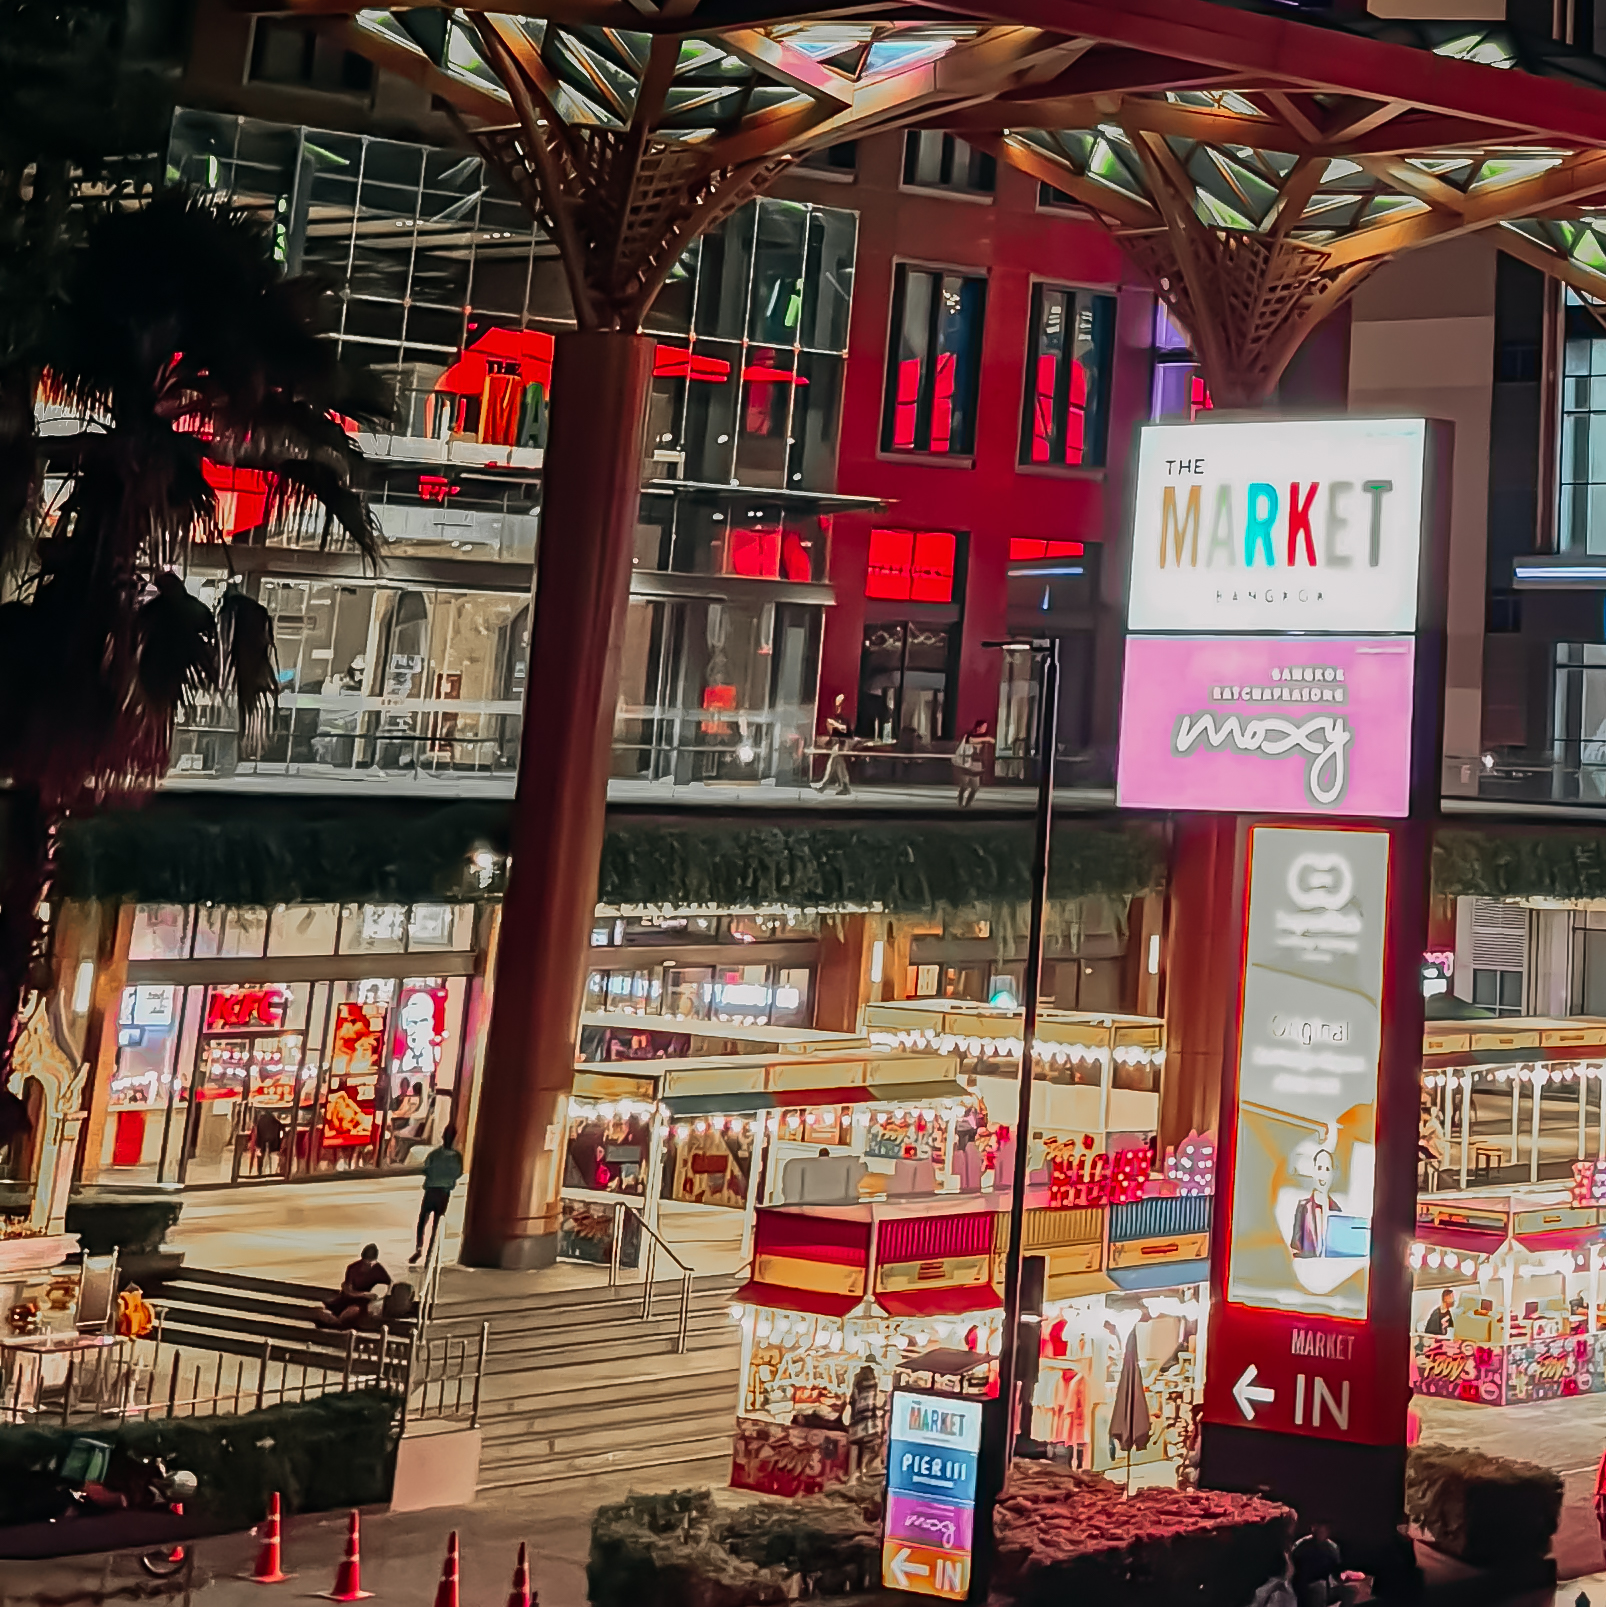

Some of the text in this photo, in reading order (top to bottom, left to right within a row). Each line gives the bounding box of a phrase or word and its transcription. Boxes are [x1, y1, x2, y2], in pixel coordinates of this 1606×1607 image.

[1165, 458, 1206, 475] THE
[1159, 479, 1393, 569] MARKET
[208, 989, 284, 1026] KFC
[1291, 1328, 1355, 1361] MARKET
[1294, 1373, 1350, 1431] IN
[908, 1405, 966, 1438] MARKET
[902, 1453, 943, 1478] PIER
[935, 1558, 962, 1593] IN
